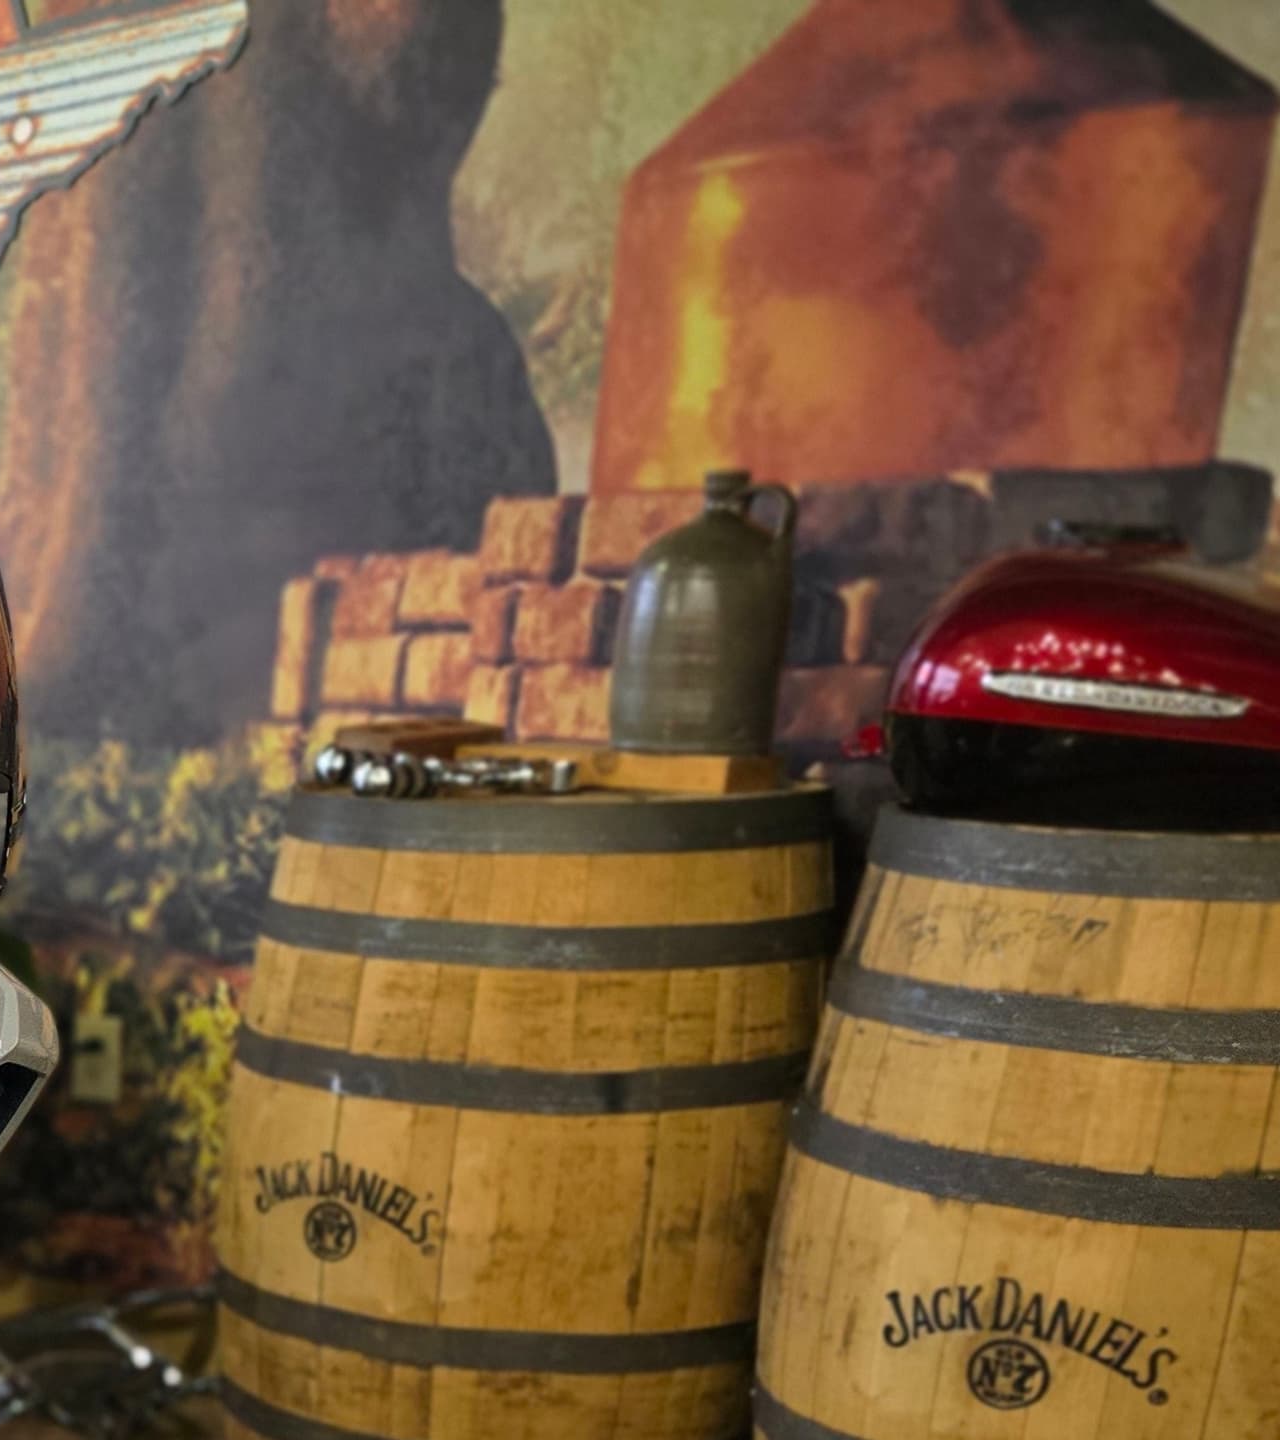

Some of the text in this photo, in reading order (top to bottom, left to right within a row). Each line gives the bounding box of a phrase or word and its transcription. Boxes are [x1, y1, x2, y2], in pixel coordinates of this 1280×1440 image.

[255, 1159, 312, 1213] JACK
[883, 1276, 1178, 1389] JACK DANIEL'S
